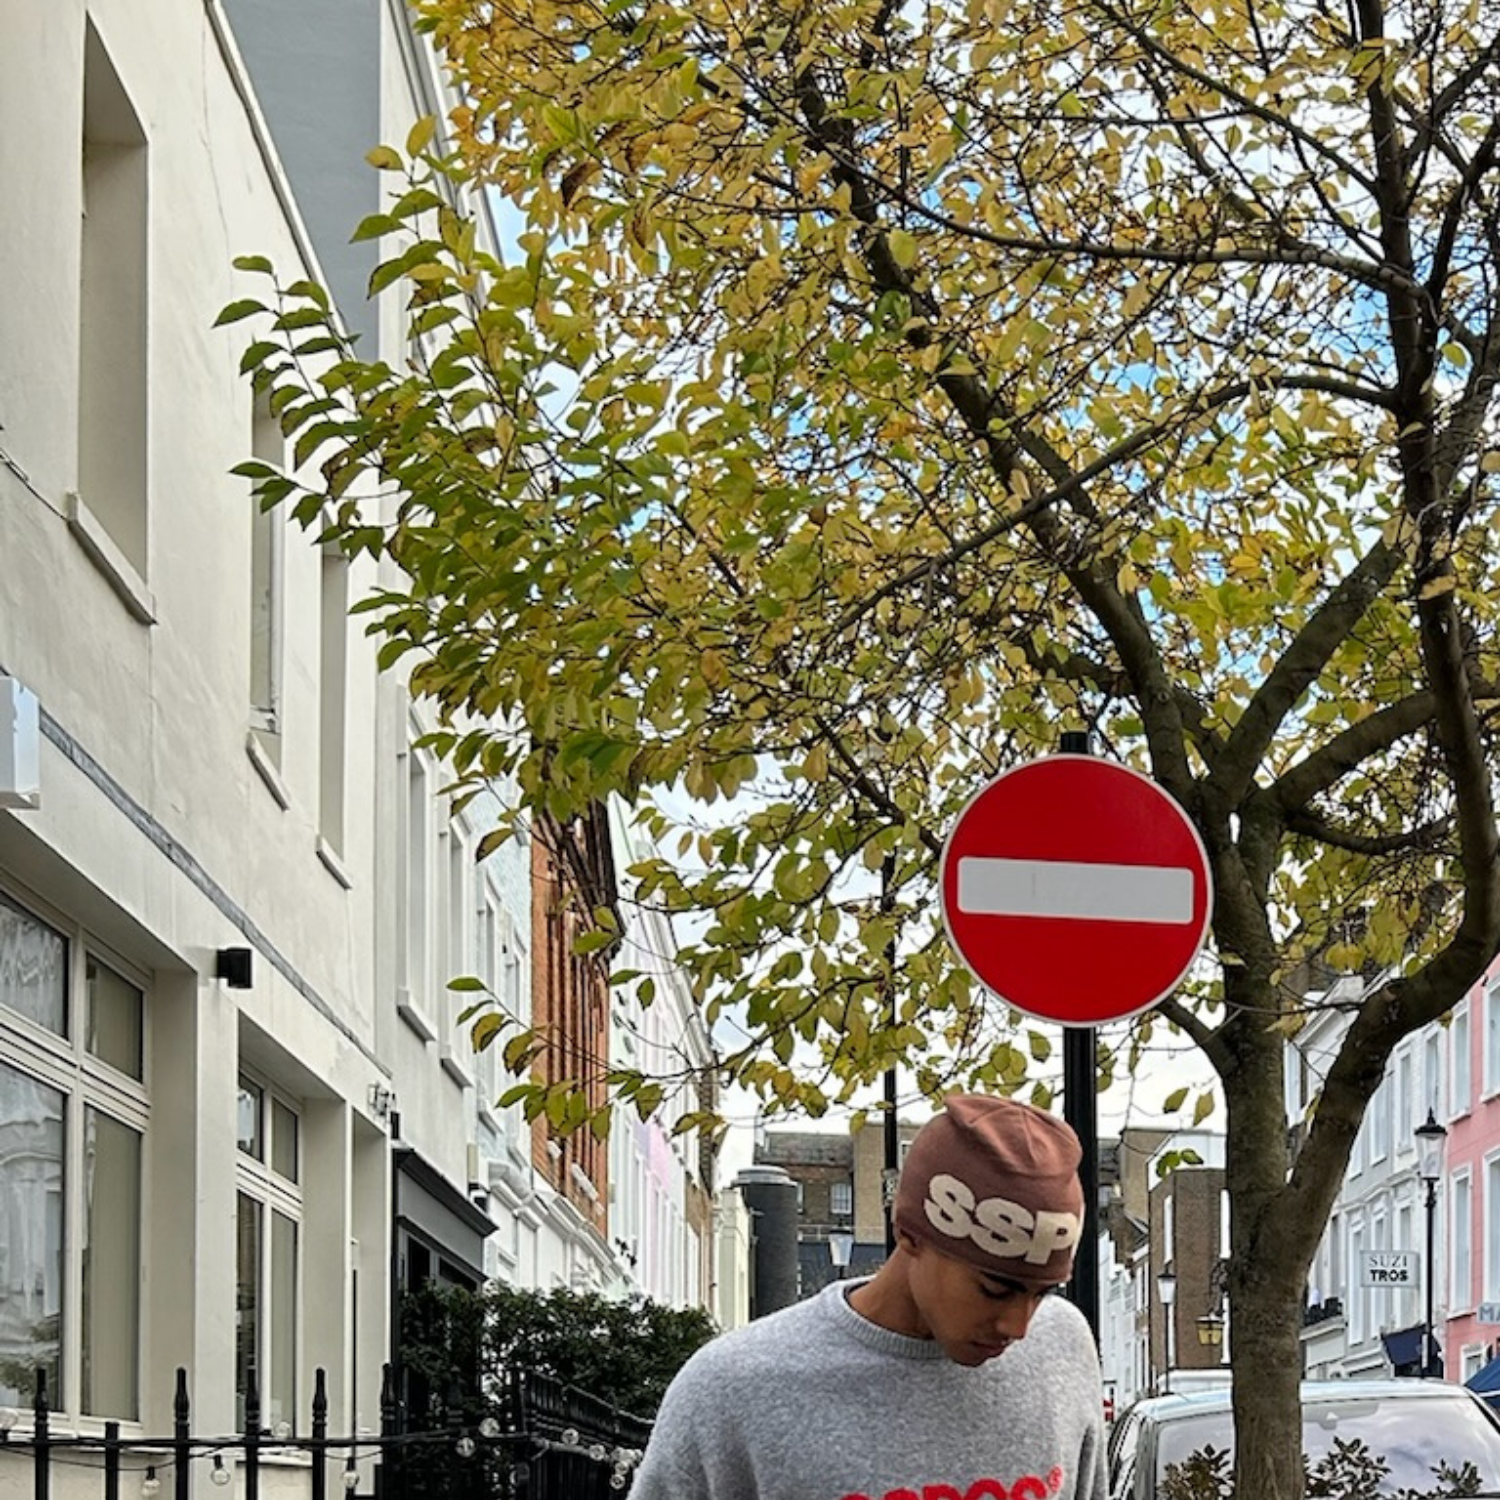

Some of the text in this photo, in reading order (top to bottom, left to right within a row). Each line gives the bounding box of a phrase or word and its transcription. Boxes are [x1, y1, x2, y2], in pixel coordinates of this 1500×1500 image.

[924, 1174, 1084, 1265] SSP
[1368, 1254, 1407, 1268] SUZI
[1369, 1269, 1408, 1282] TROS
